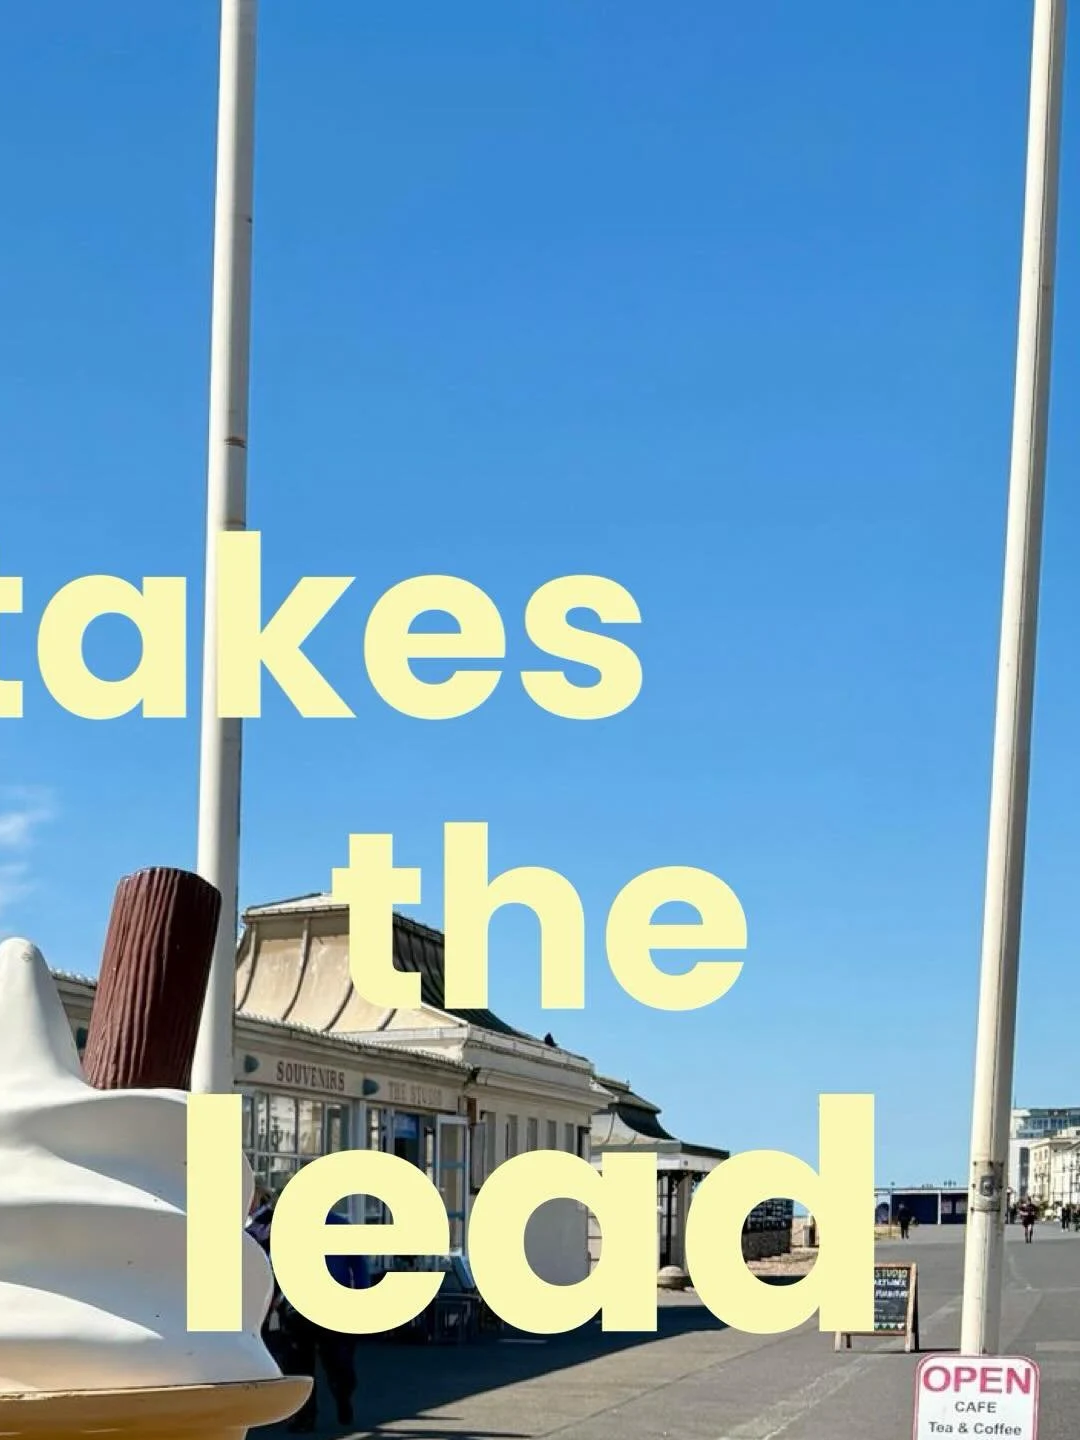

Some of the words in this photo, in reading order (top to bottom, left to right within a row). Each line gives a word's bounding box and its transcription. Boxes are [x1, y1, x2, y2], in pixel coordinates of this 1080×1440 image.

[276, 1060, 345, 1092] SOUVENIRS
[923, 1365, 1031, 1394] OPEN
[955, 1401, 997, 1414] CAFE
[928, 1421, 953, 1433] Tea
[958, 1422, 968, 1433] &
[974, 1422, 1022, 1435] Coffee
